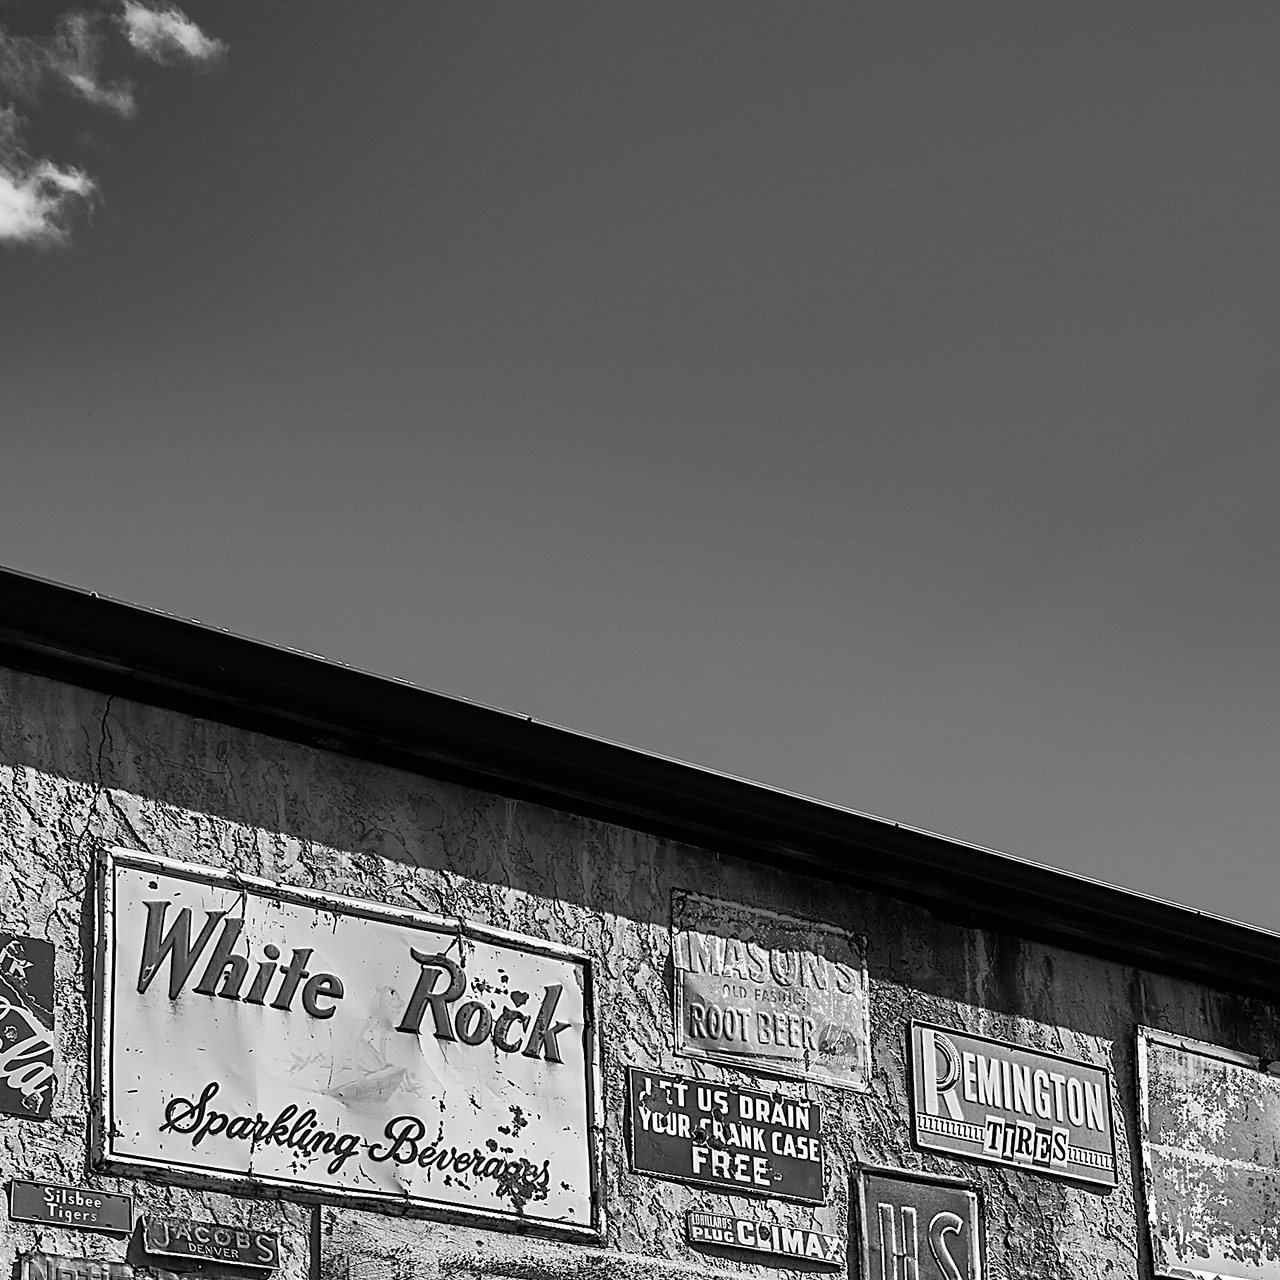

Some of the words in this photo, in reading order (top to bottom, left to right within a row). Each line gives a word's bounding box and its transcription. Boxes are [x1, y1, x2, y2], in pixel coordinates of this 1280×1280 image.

[137, 900, 345, 1020] White
[395, 946, 573, 1065] Rock
[687, 931, 857, 994] MASONS
[722, 983, 748, 999] OLD
[689, 1002, 752, 1042] ROOT
[756, 1011, 818, 1051] BEER
[922, 1028, 1106, 1132] REMINGTON
[159, 1082, 362, 1174] Sparkling
[697, 1087, 729, 1114] US
[739, 1094, 811, 1131] DRAIN
[638, 1105, 692, 1138] YOUR
[771, 1131, 821, 1162] CASE
[984, 1118, 1068, 1166] TIRES
[692, 1146, 772, 1187] FREE
[43, 1186, 102, 1208] Silsbee
[47, 1202, 97, 1223] Tigers
[152, 1221, 274, 1264] JACOBS
[189, 1242, 239, 1259] DENVER
[692, 1226, 734, 1243] PLUG
[736, 1220, 844, 1263] CLIMAX
